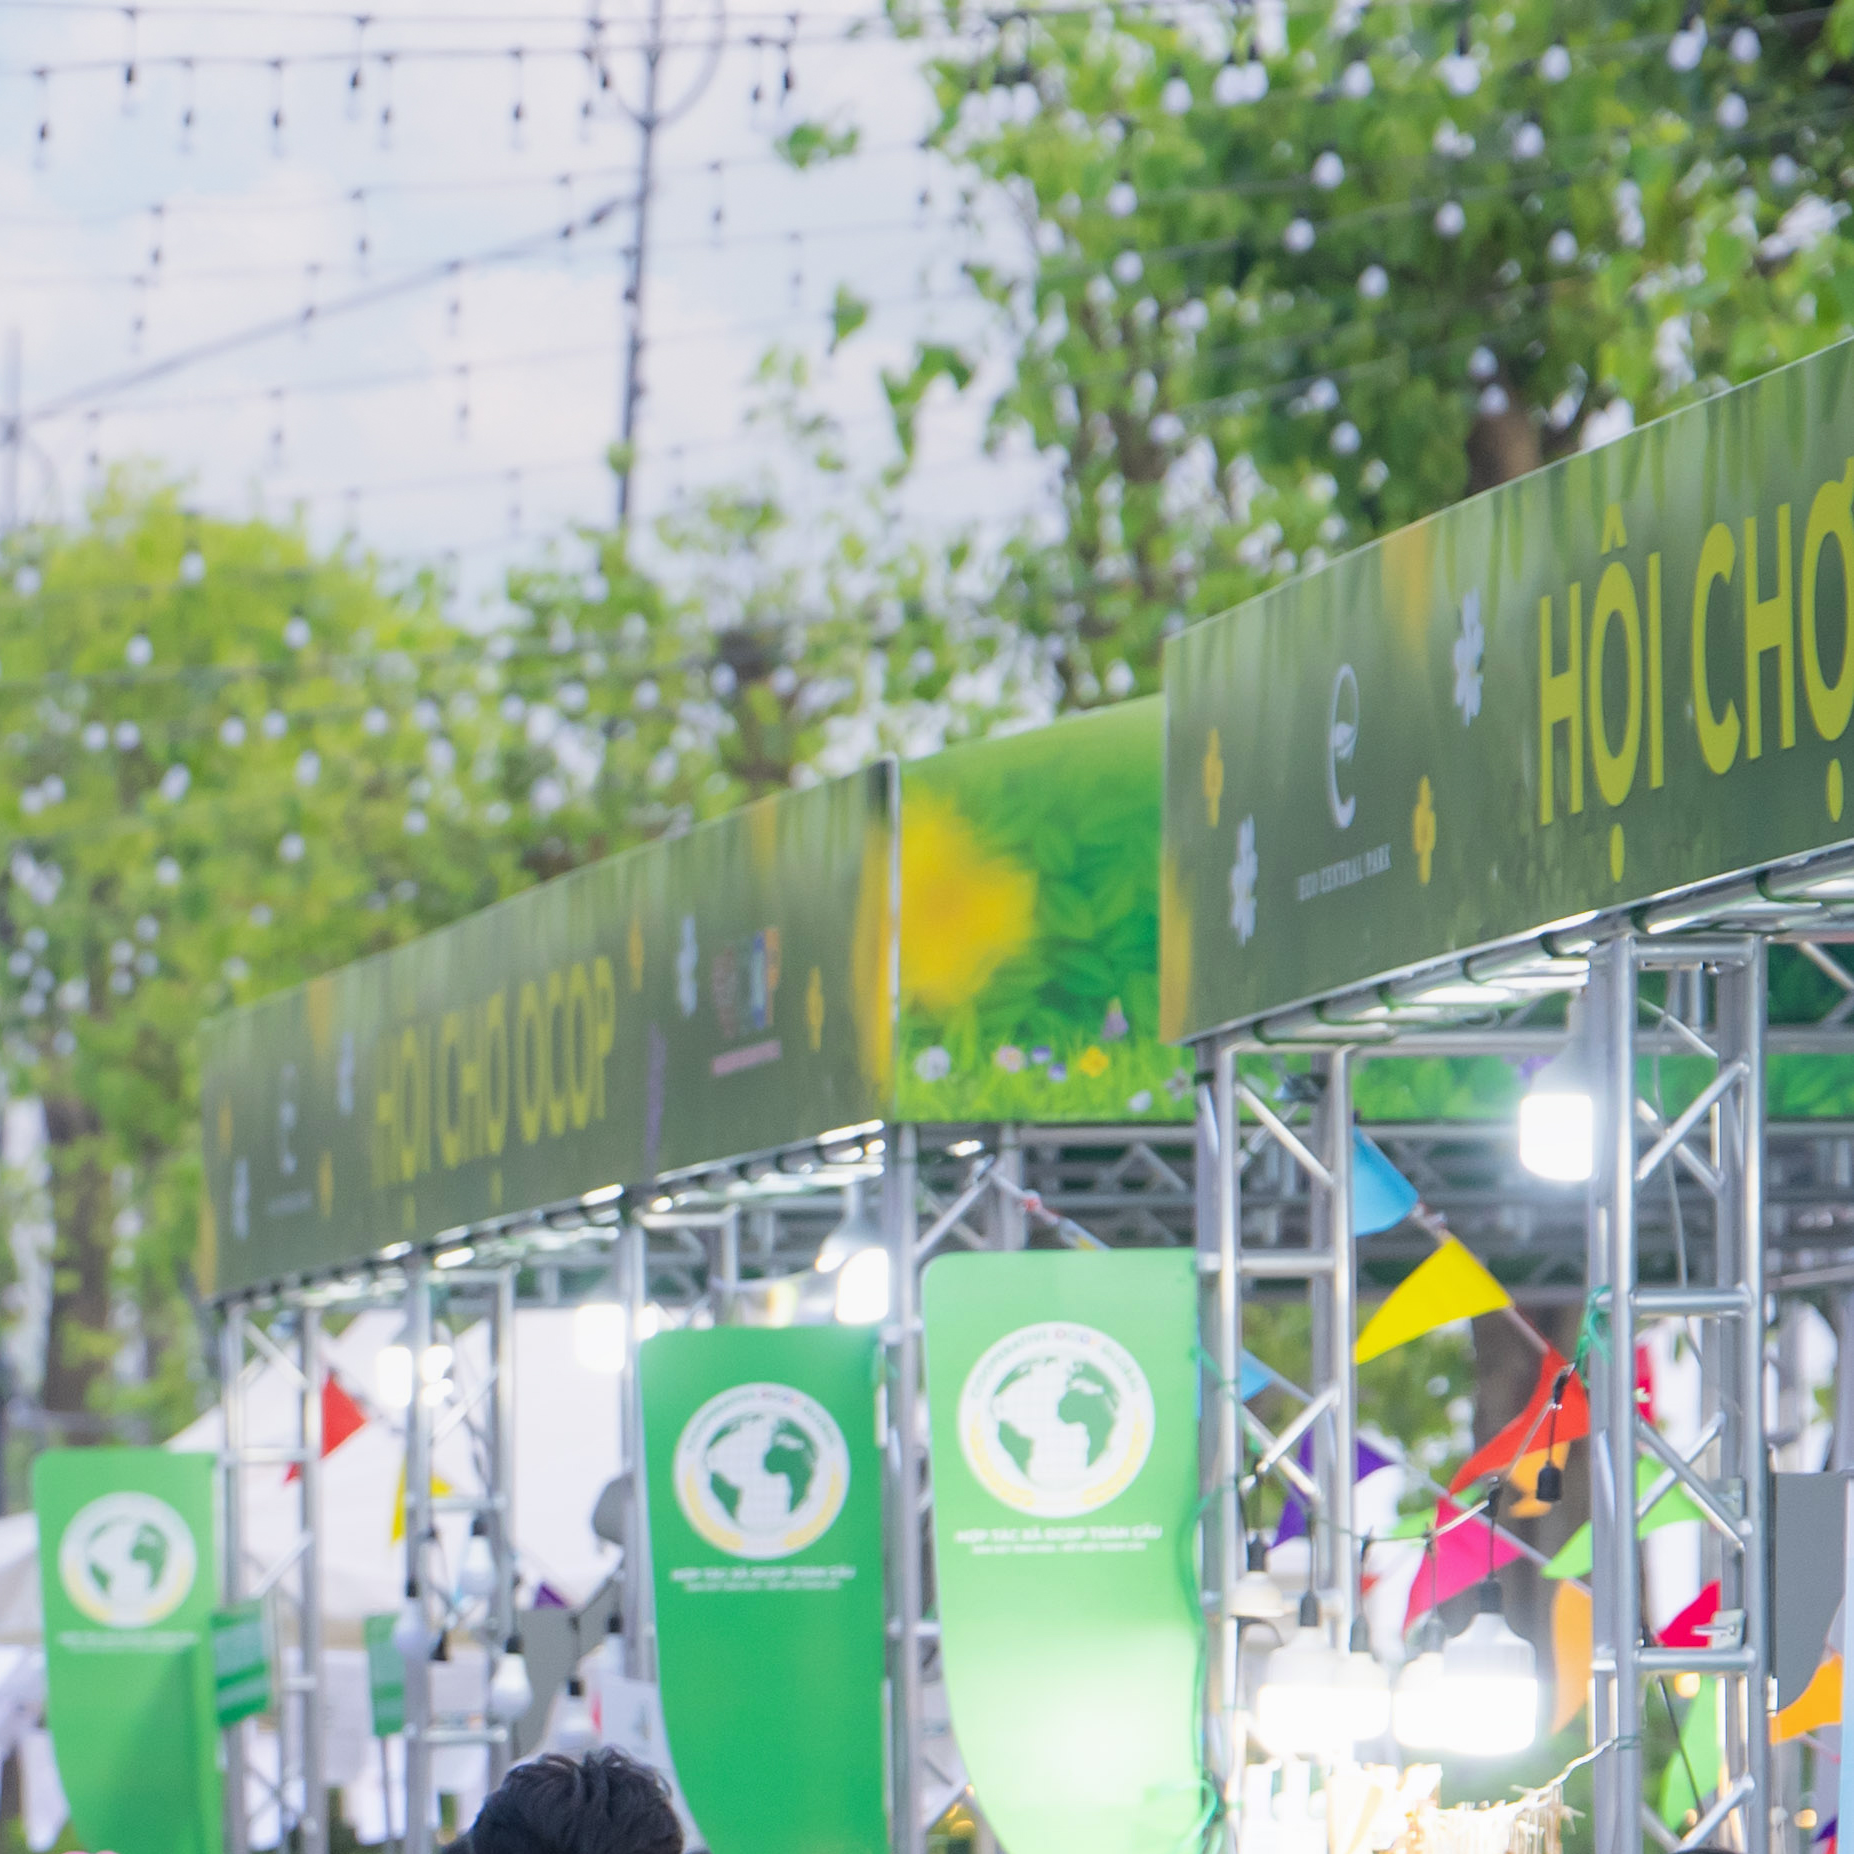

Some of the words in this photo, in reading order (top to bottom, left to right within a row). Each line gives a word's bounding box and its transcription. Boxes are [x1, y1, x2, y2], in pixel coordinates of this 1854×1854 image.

[1539, 503, 1665, 883] HỘI
[1320, 855, 1364, 894] CENTRAL
[1365, 842, 1392, 878] PARK
[518, 955, 616, 1146] OCOP
